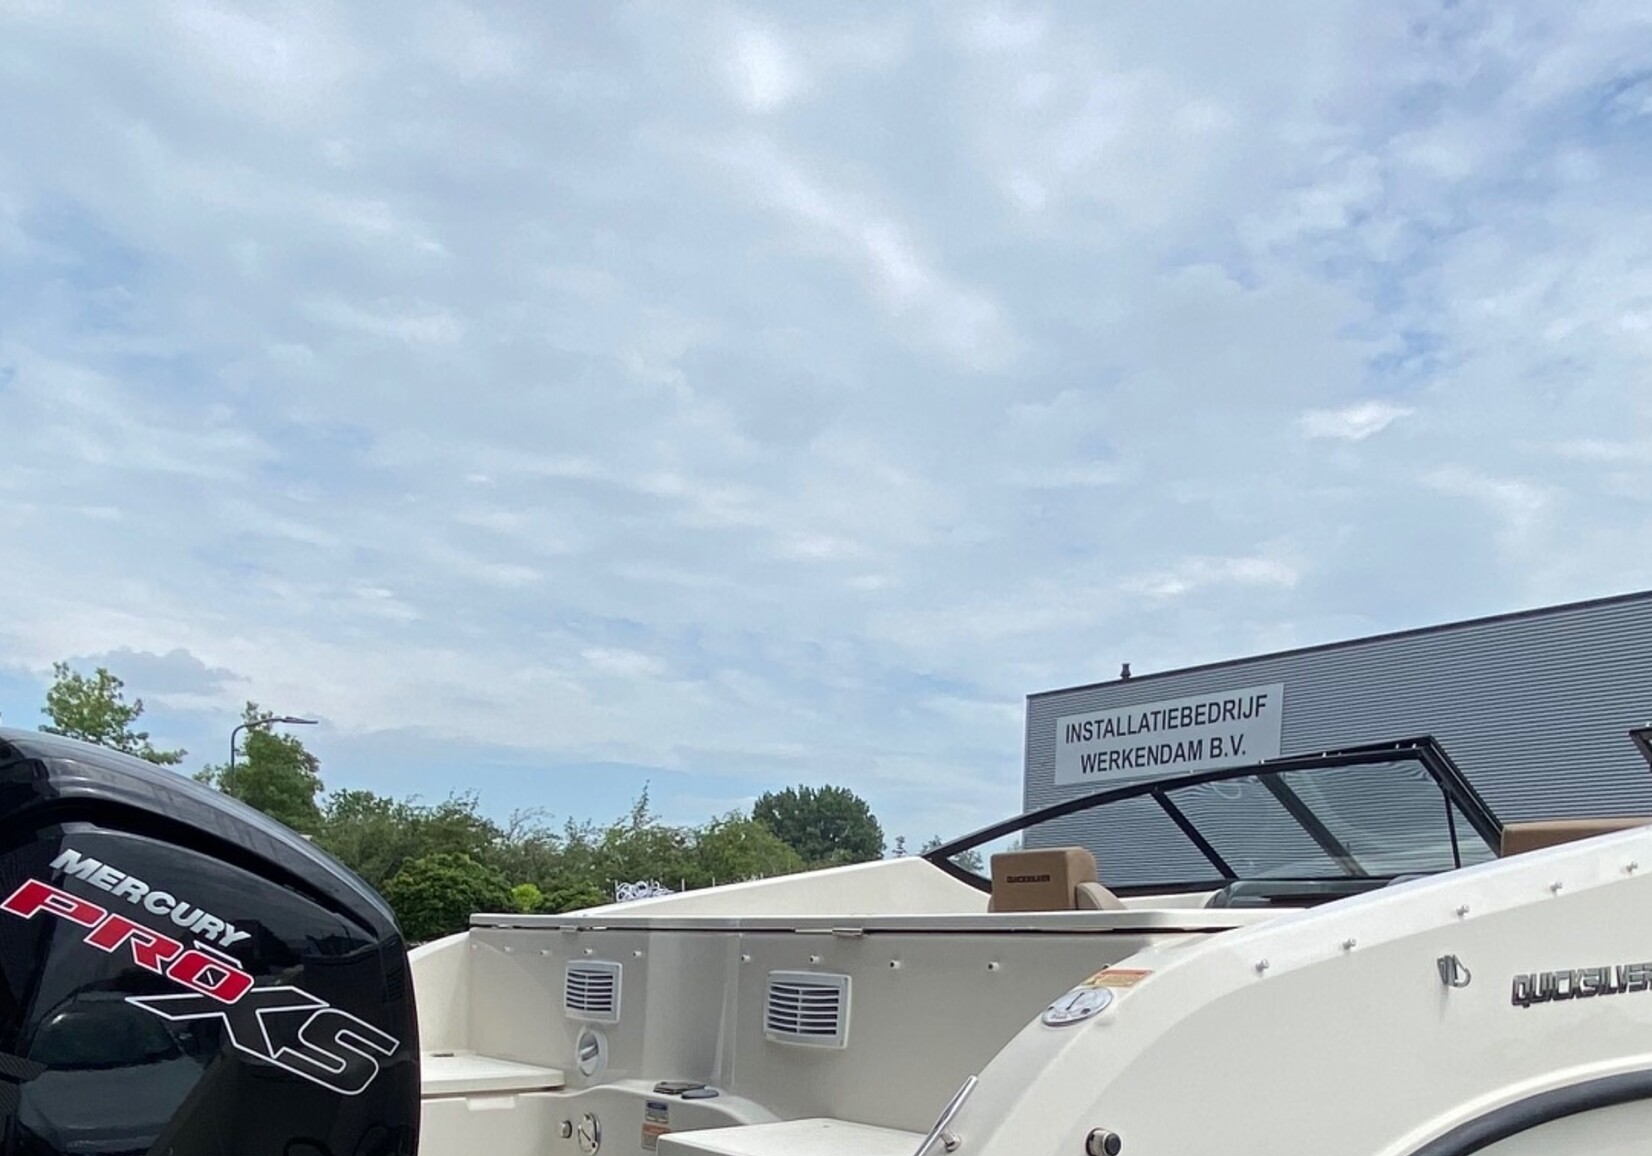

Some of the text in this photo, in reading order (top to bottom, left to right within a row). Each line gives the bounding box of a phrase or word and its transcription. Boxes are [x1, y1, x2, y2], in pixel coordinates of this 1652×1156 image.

[1065, 694, 1267, 744] INSTALLATIEBEDRIJF
[1080, 733, 1246, 774] WERKENDAM B.V.
[0, 878, 255, 1004] PRO
[49, 848, 251, 948] MERCURY
[124, 940, 400, 1095] XS
